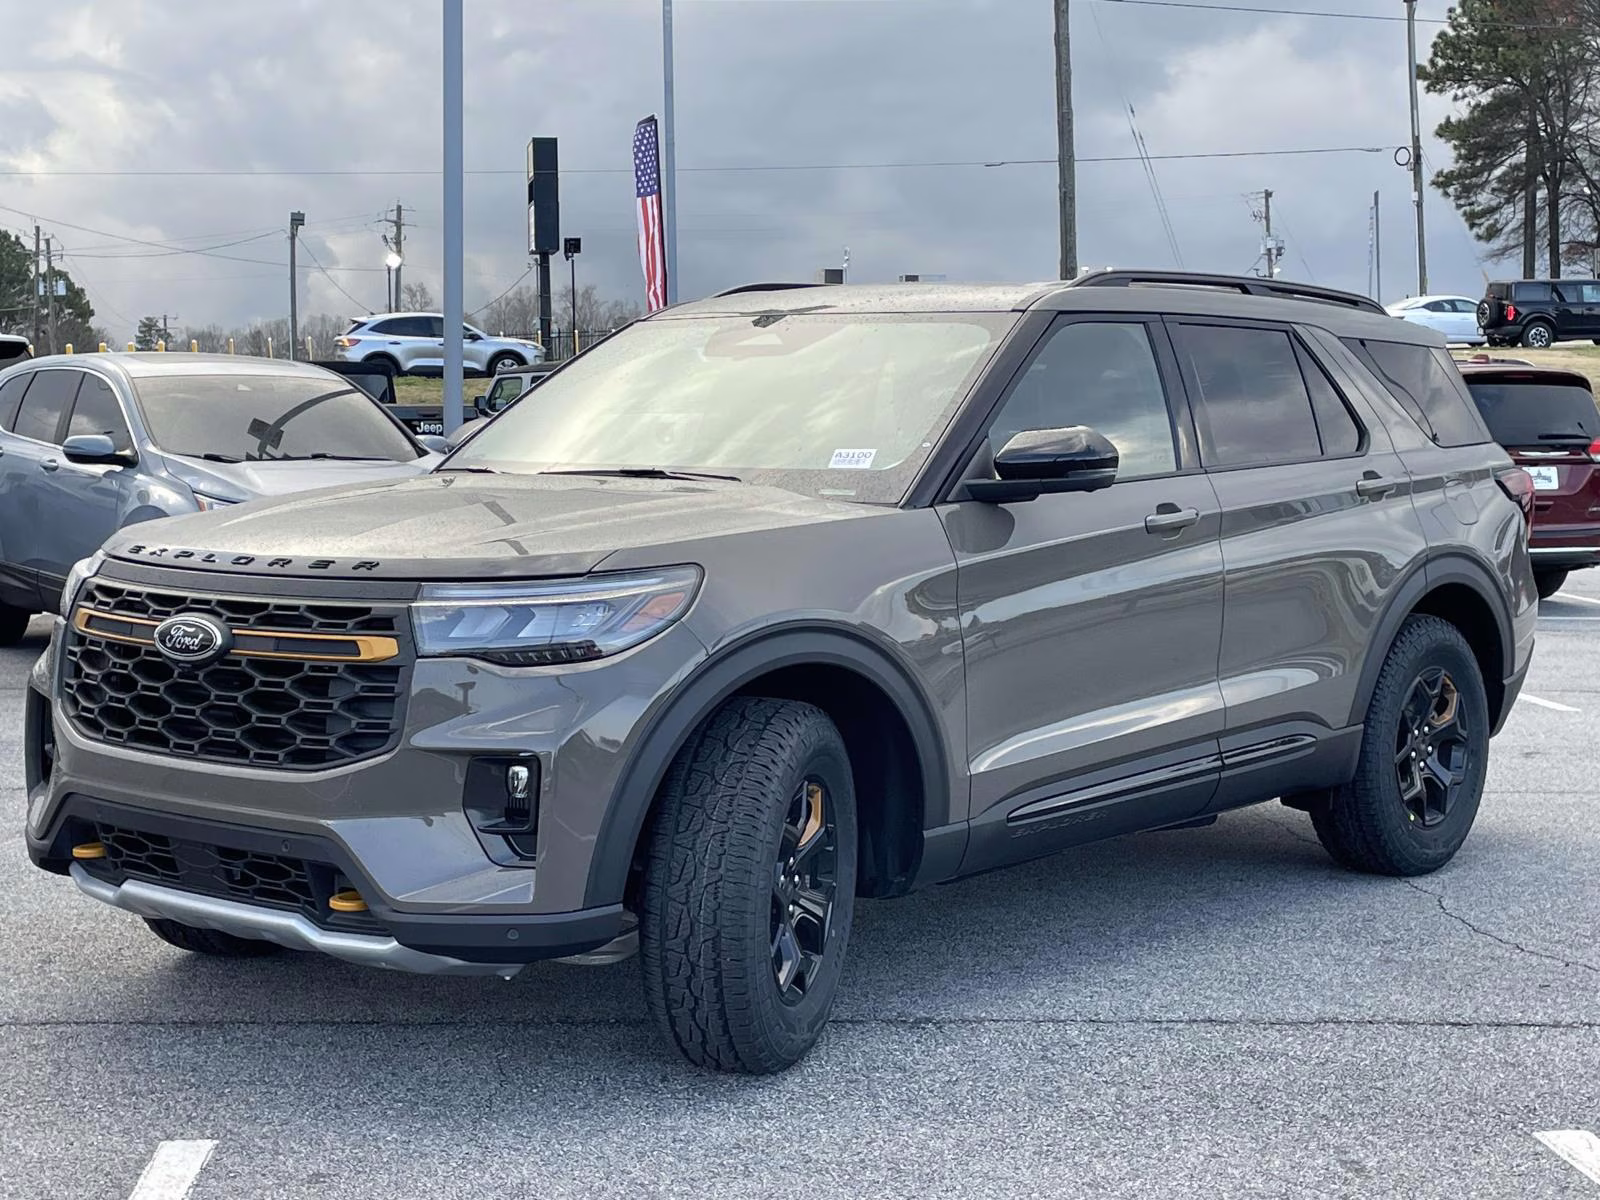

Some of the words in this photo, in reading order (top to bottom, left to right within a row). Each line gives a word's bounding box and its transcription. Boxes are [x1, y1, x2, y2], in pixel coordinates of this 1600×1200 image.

[416, 421, 443, 434] Jeep
[834, 451, 873, 459] A3100
[127, 544, 381, 571] EXPLORER
[165, 624, 205, 651] Ford
